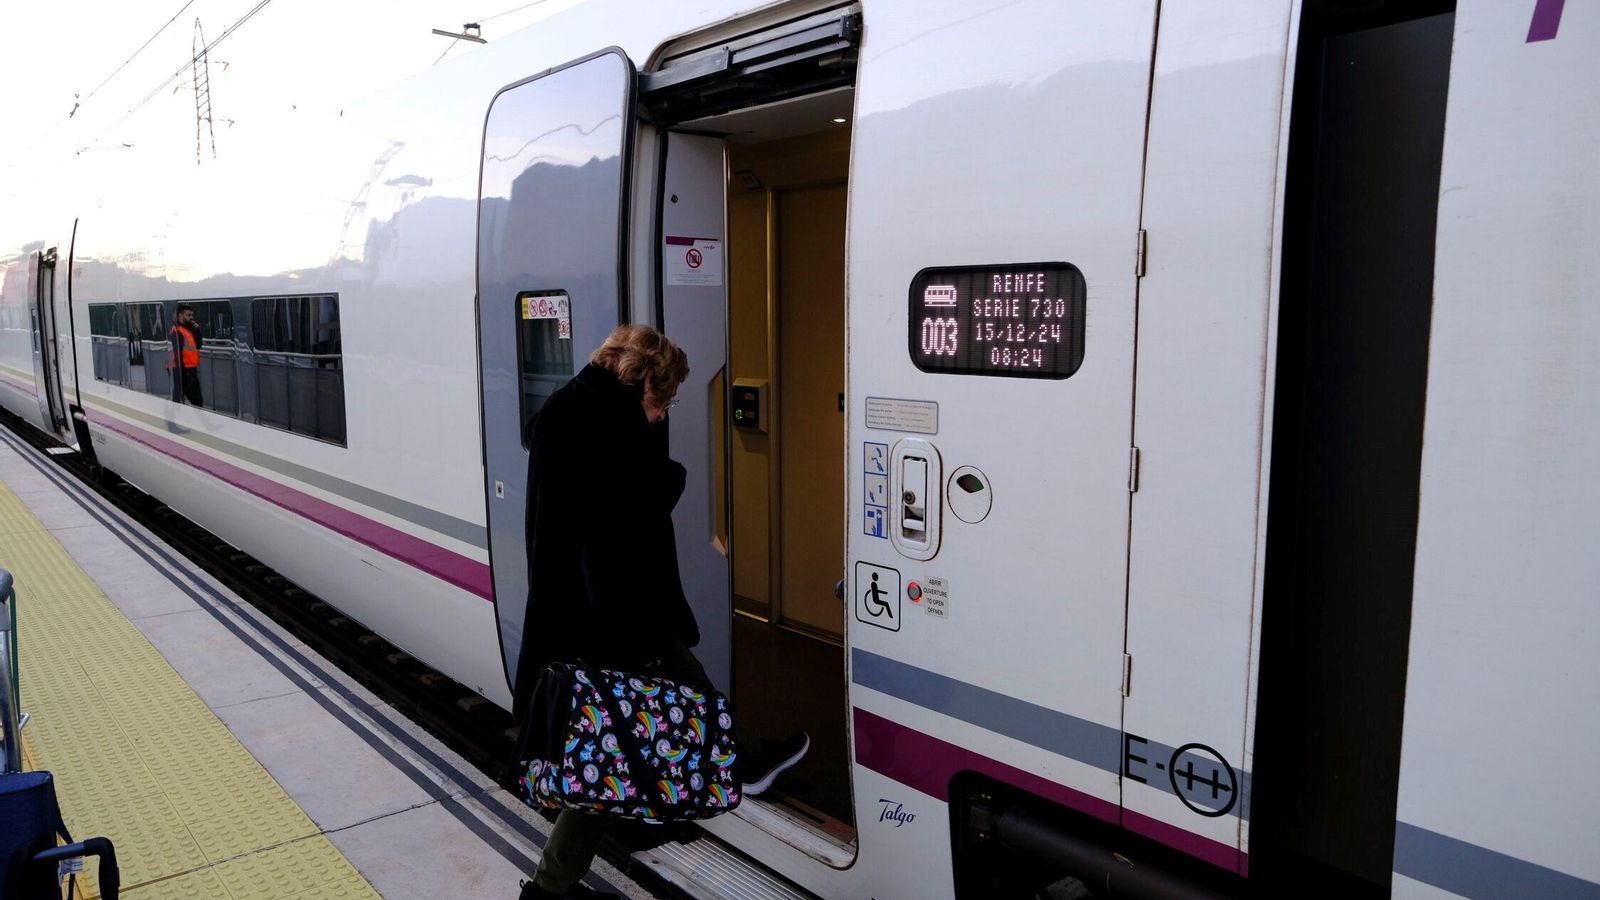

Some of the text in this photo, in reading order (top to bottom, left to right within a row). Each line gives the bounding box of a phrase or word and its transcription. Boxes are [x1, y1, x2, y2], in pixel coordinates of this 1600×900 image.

[993, 273, 1045, 293] RENFE
[973, 298, 1065, 318] SERIE 730
[921, 317, 958, 356] 003
[975, 322, 1061, 343] 15/12/24
[991, 347, 1042, 368] 08:24
[878, 798, 917, 828] Talgo
